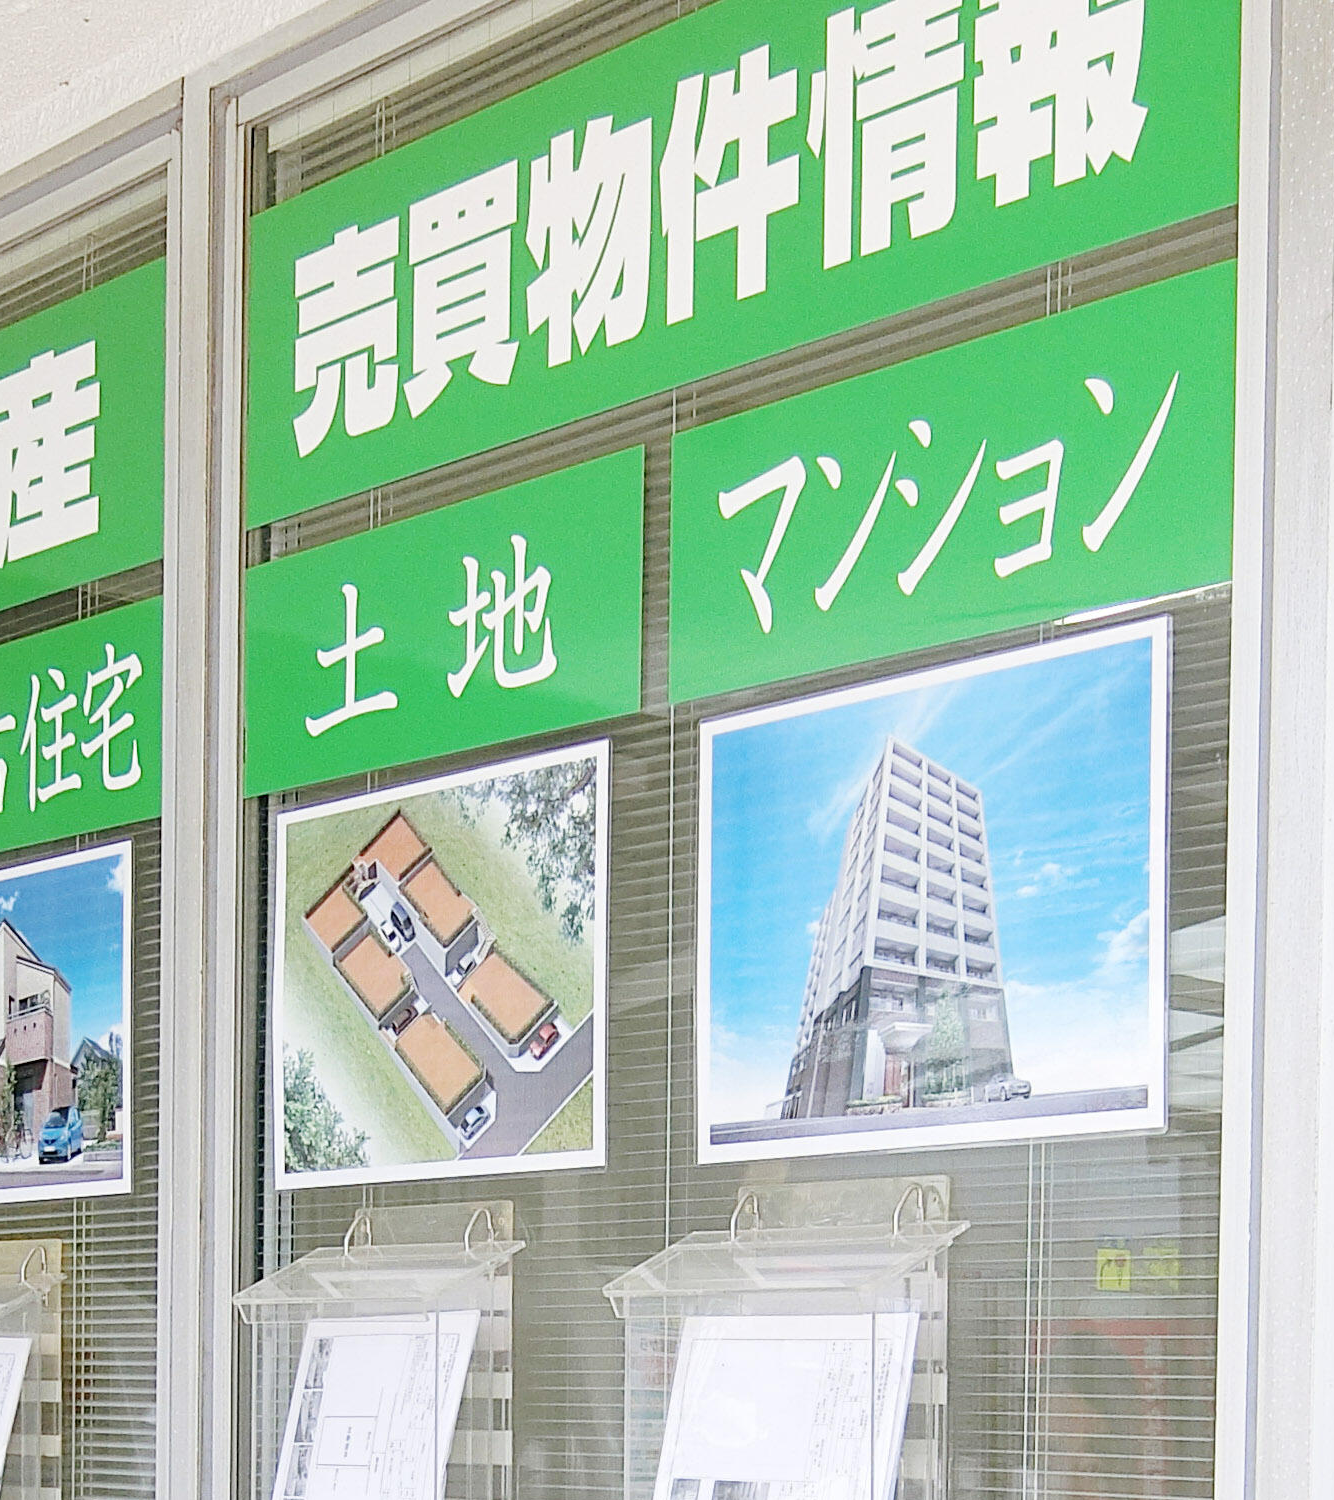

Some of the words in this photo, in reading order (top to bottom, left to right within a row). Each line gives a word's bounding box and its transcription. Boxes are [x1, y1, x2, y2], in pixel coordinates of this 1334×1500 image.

[293, 0, 1149, 457] 売買物件情報
[718, 370, 1180, 635] マンション
[305, 534, 558, 737] 土地
